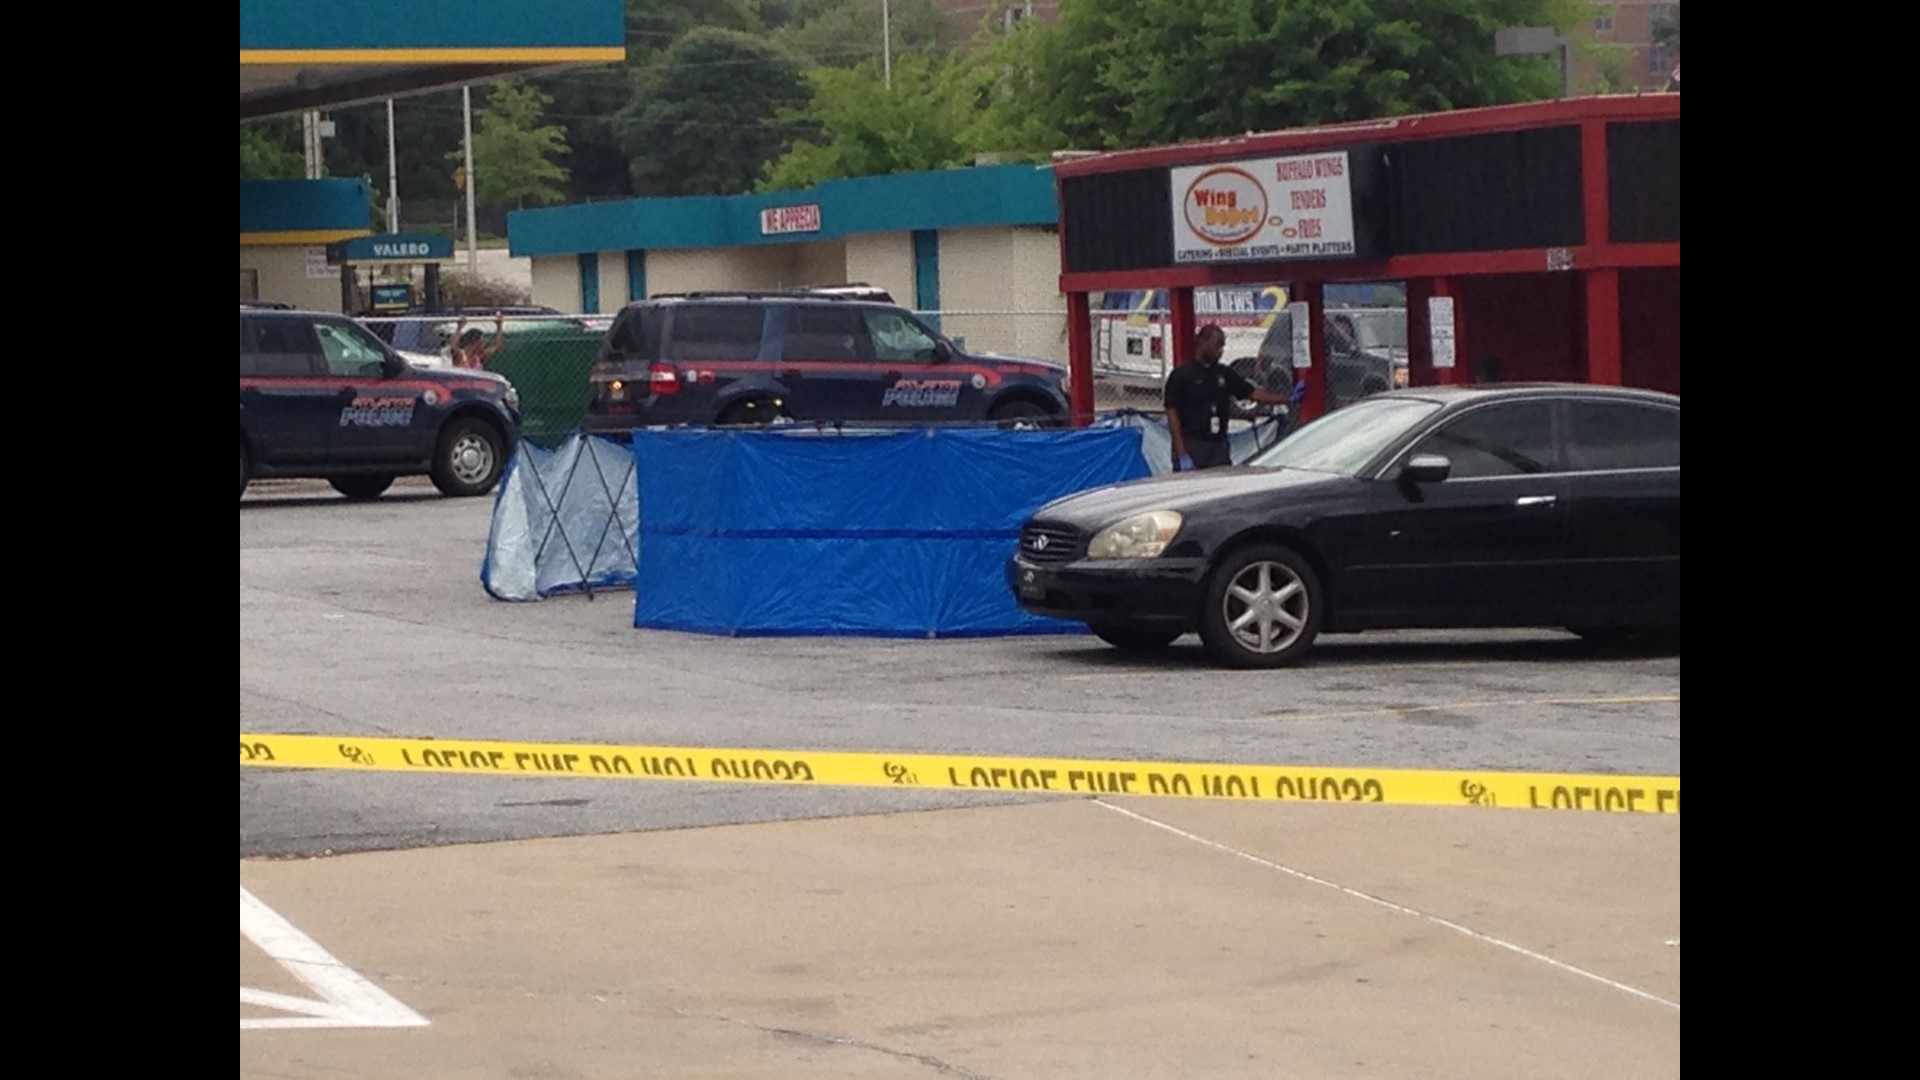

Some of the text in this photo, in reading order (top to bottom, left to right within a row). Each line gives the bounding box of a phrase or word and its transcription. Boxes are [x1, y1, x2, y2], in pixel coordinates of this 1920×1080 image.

[1276, 156, 1343, 181] BUFFALO WINGS
[1193, 189, 1236, 208] Wing
[1290, 188, 1326, 211] TENDERS
[1298, 218, 1322, 239] FRIES
[373, 243, 430, 256] VALERO
[1220, 290, 1254, 312] NEWS
